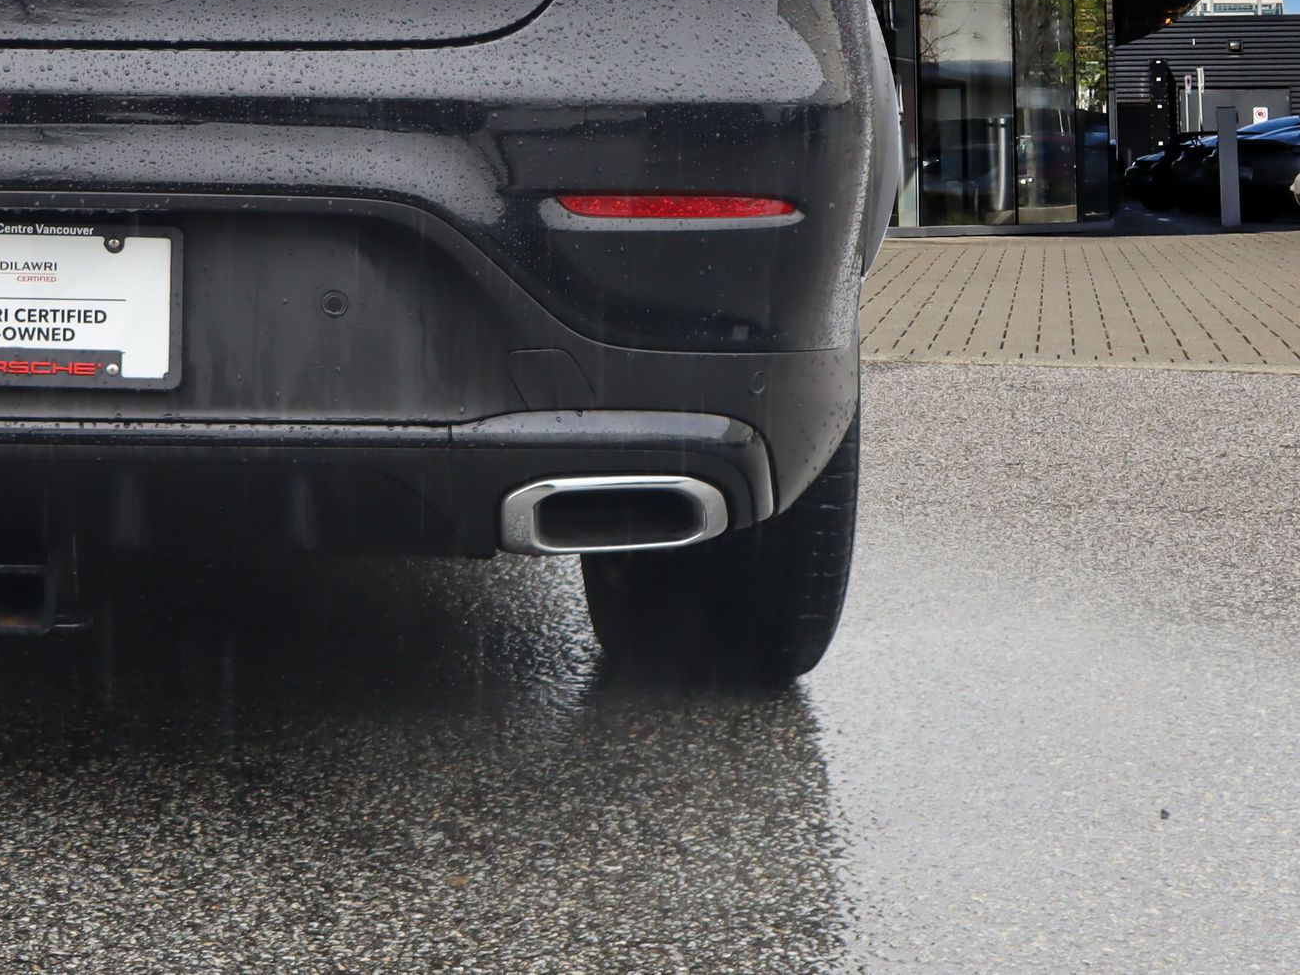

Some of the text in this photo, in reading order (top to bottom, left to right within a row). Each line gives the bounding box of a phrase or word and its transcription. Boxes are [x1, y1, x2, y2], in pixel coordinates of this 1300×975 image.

[35, 224, 94, 236] Vancouver
[0, 261, 58, 272] DILAWRI
[16, 275, 57, 283] CERTIFIED
[14, 308, 107, 325] CERTIFIED
